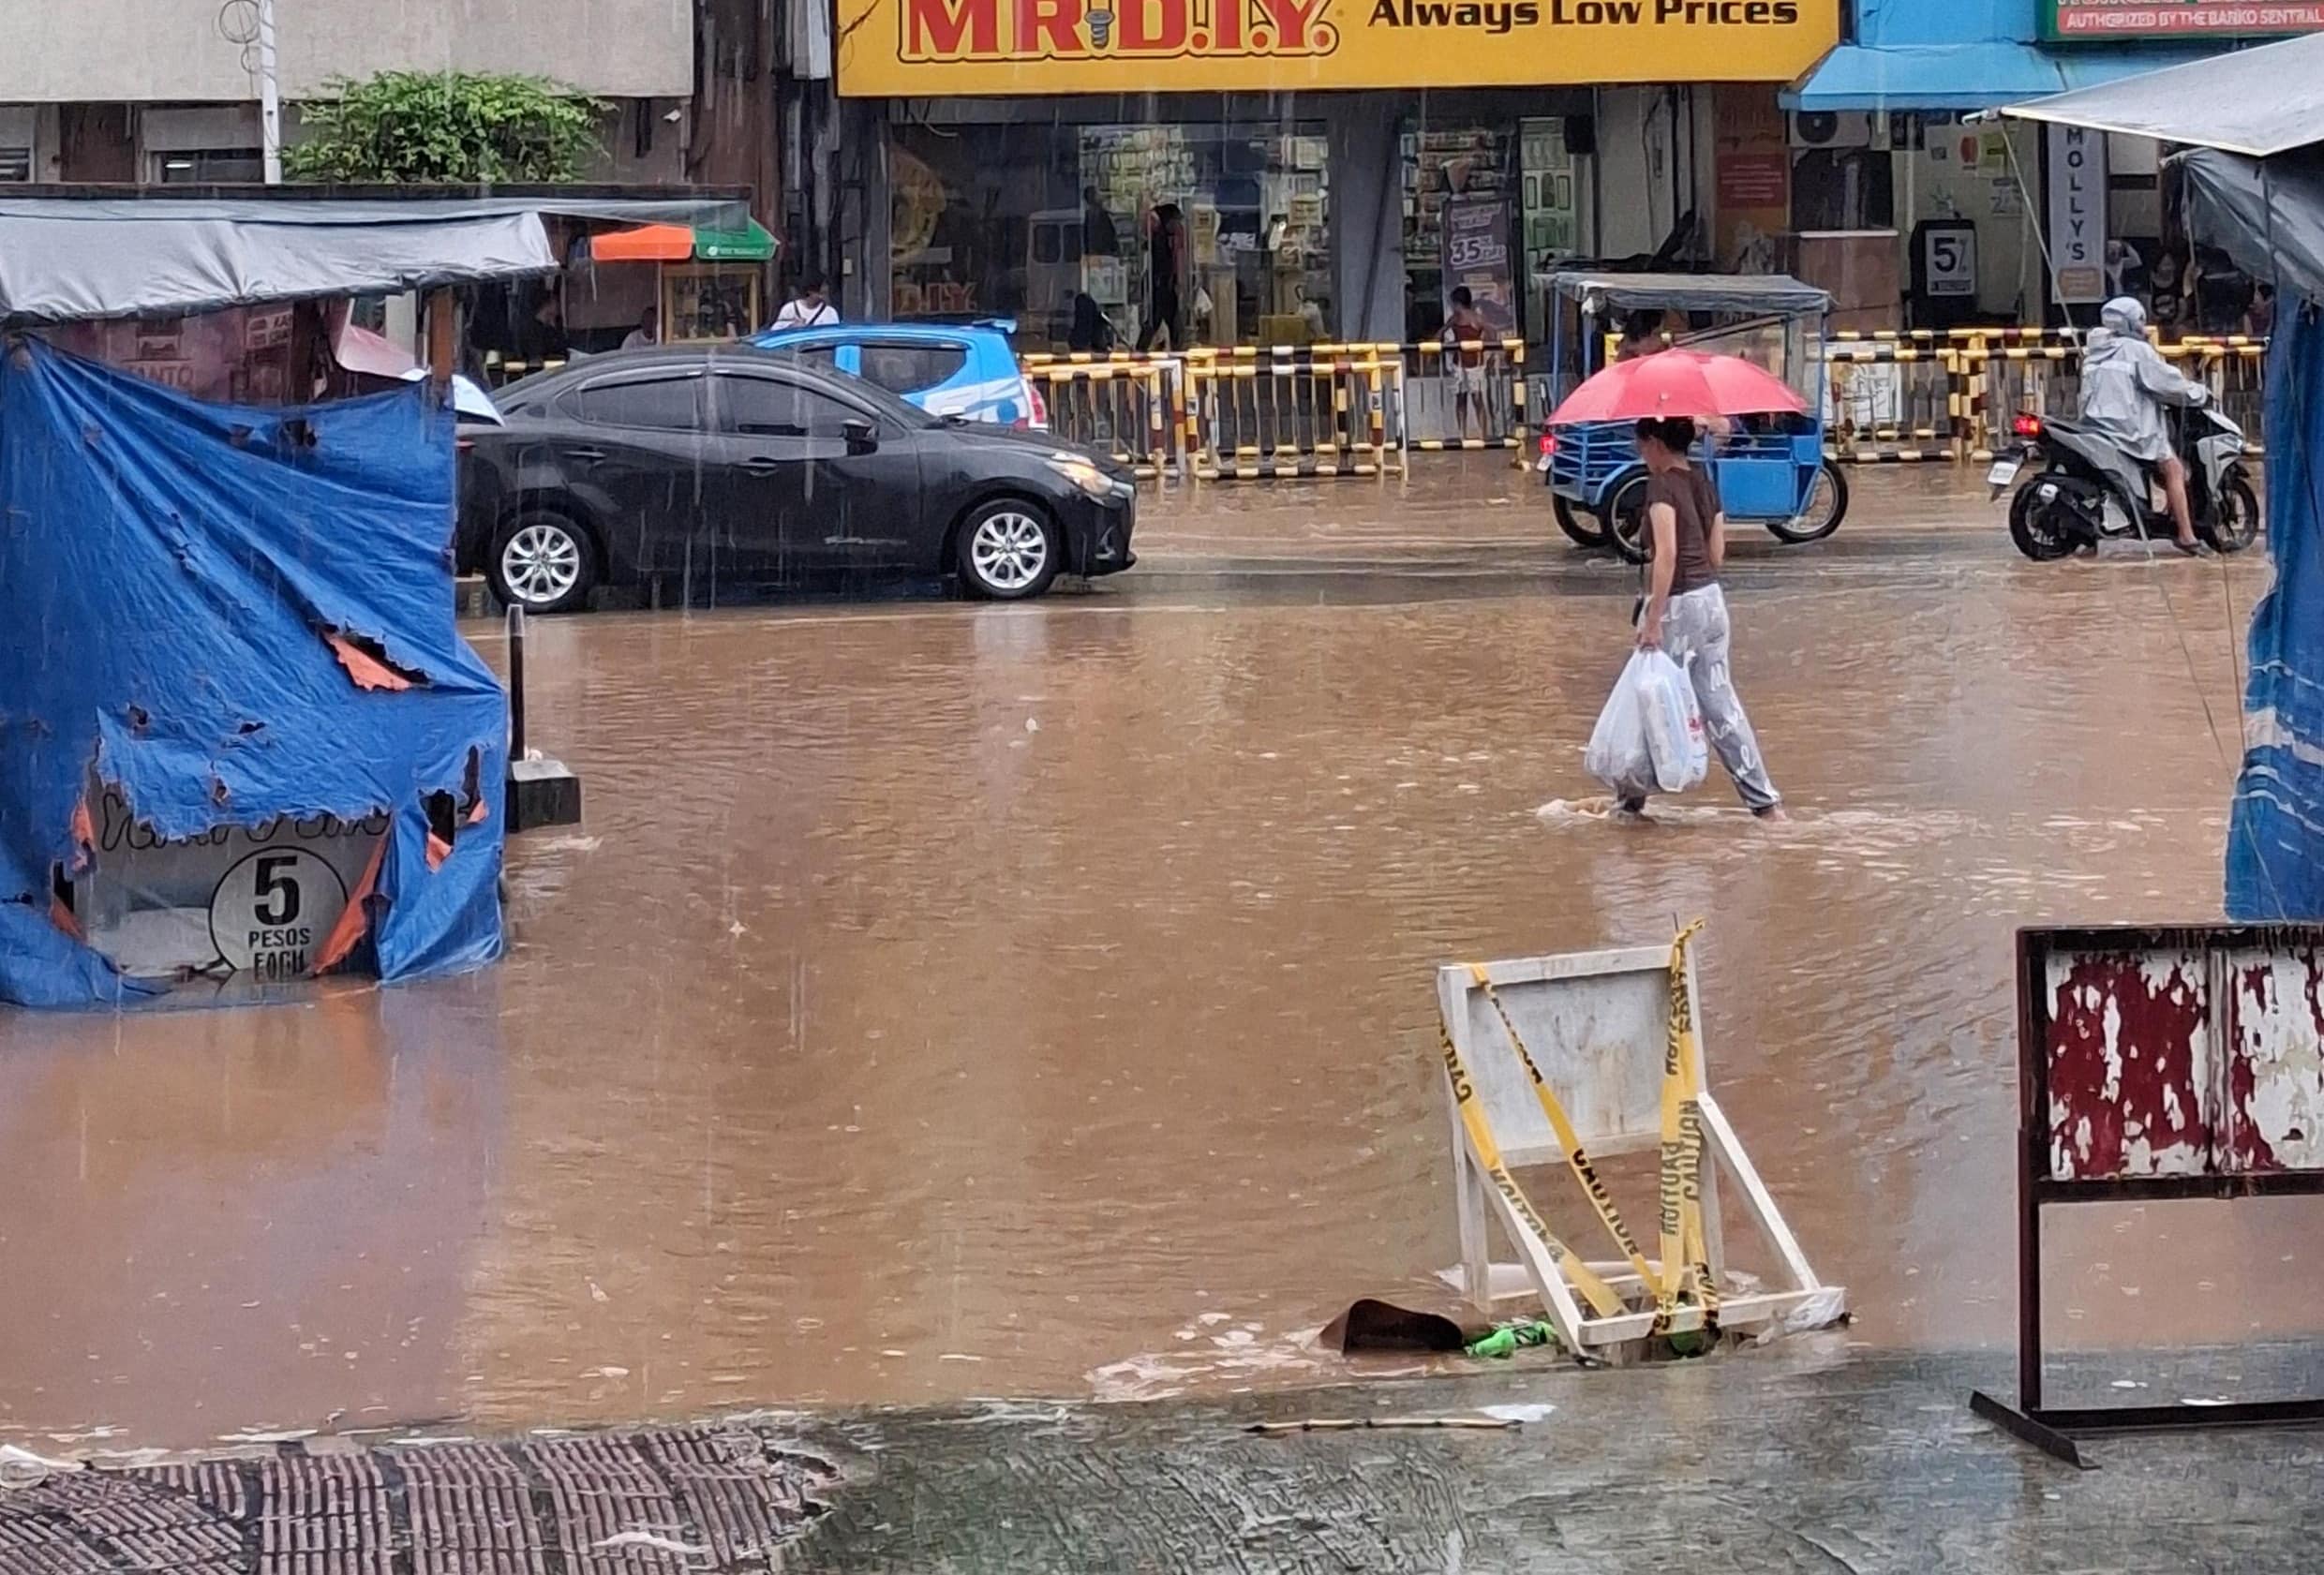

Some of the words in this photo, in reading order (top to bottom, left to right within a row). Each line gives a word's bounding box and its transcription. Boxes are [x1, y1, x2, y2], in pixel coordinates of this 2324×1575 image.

[1367, 0, 1540, 35] Always
[1551, 0, 1643, 25] Low
[1654, 0, 1798, 25] Prices
[2066, 11, 2156, 29] AUTHORIZED
[2158, 11, 2179, 27] BY
[2179, 10, 2208, 26] THE
[2258, 7, 2324, 25] SENTRAL
[2066, 127, 2085, 260] MOLLY'S
[254, 854, 300, 926] 5
[247, 928, 311, 949] PESOS
